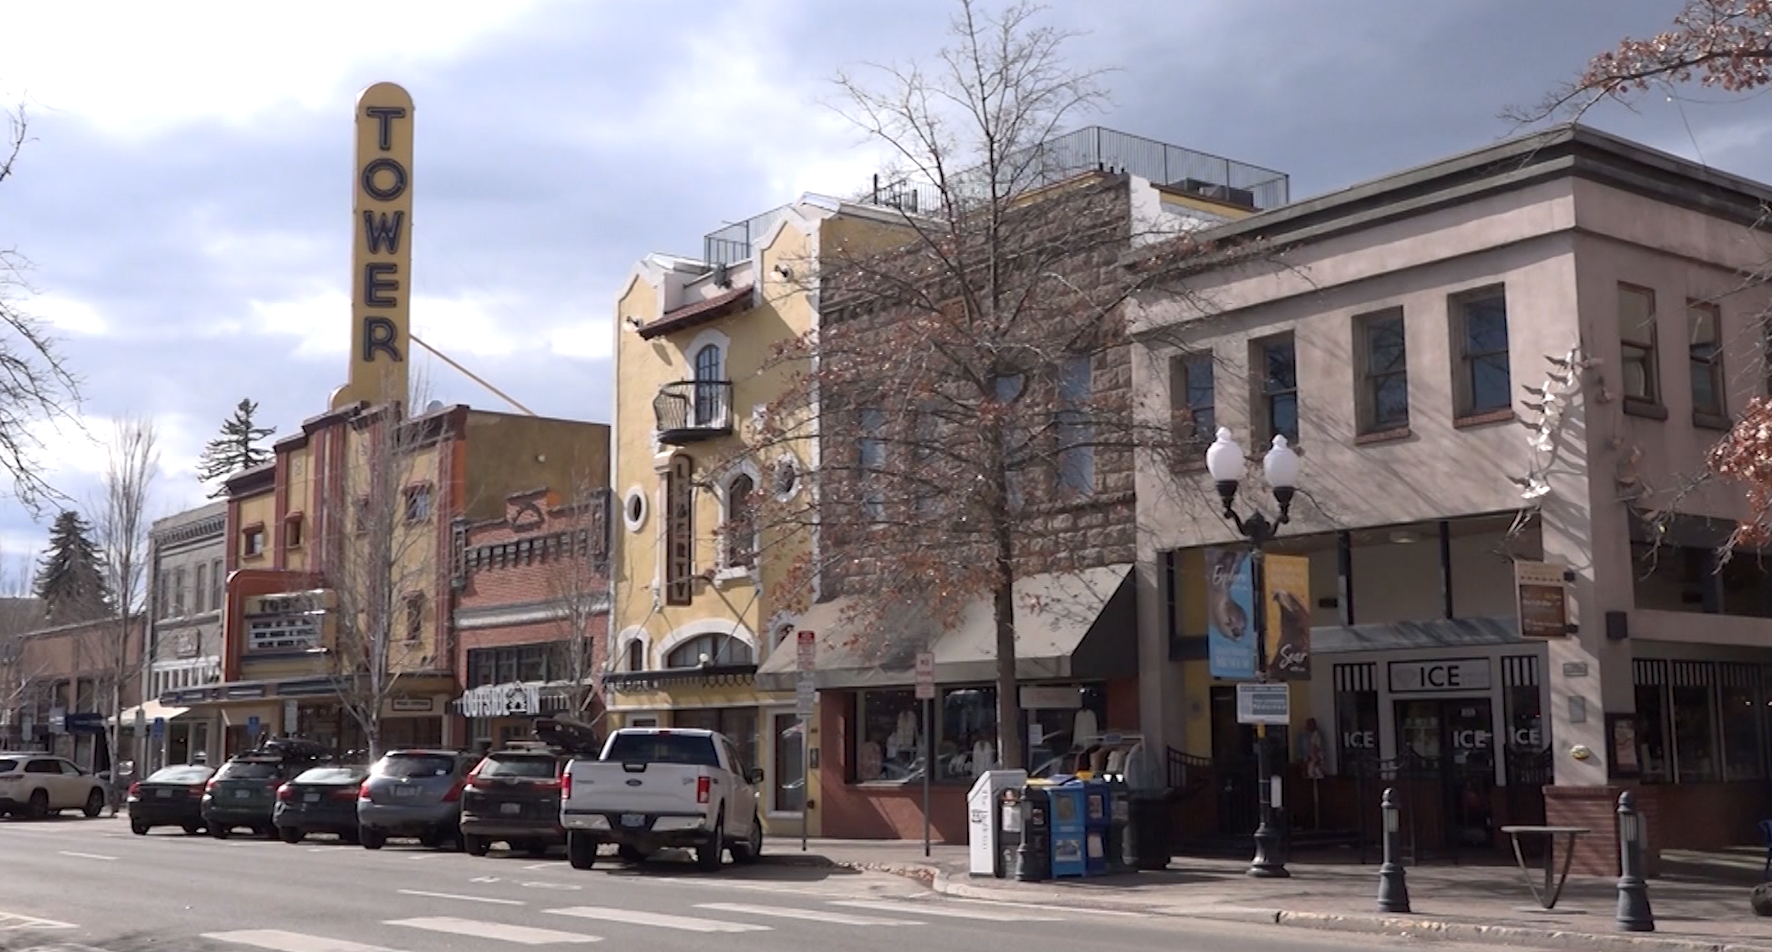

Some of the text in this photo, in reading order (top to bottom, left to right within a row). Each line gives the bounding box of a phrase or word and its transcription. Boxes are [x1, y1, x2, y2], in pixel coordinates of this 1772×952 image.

[361, 106, 408, 363] TOWER
[1420, 664, 1460, 687] ICE
[462, 685, 511, 718] OUTSIDE
[1343, 731, 1375, 749] ICE
[1453, 729, 1487, 749] ICE
[1511, 727, 1541, 745] ICE
